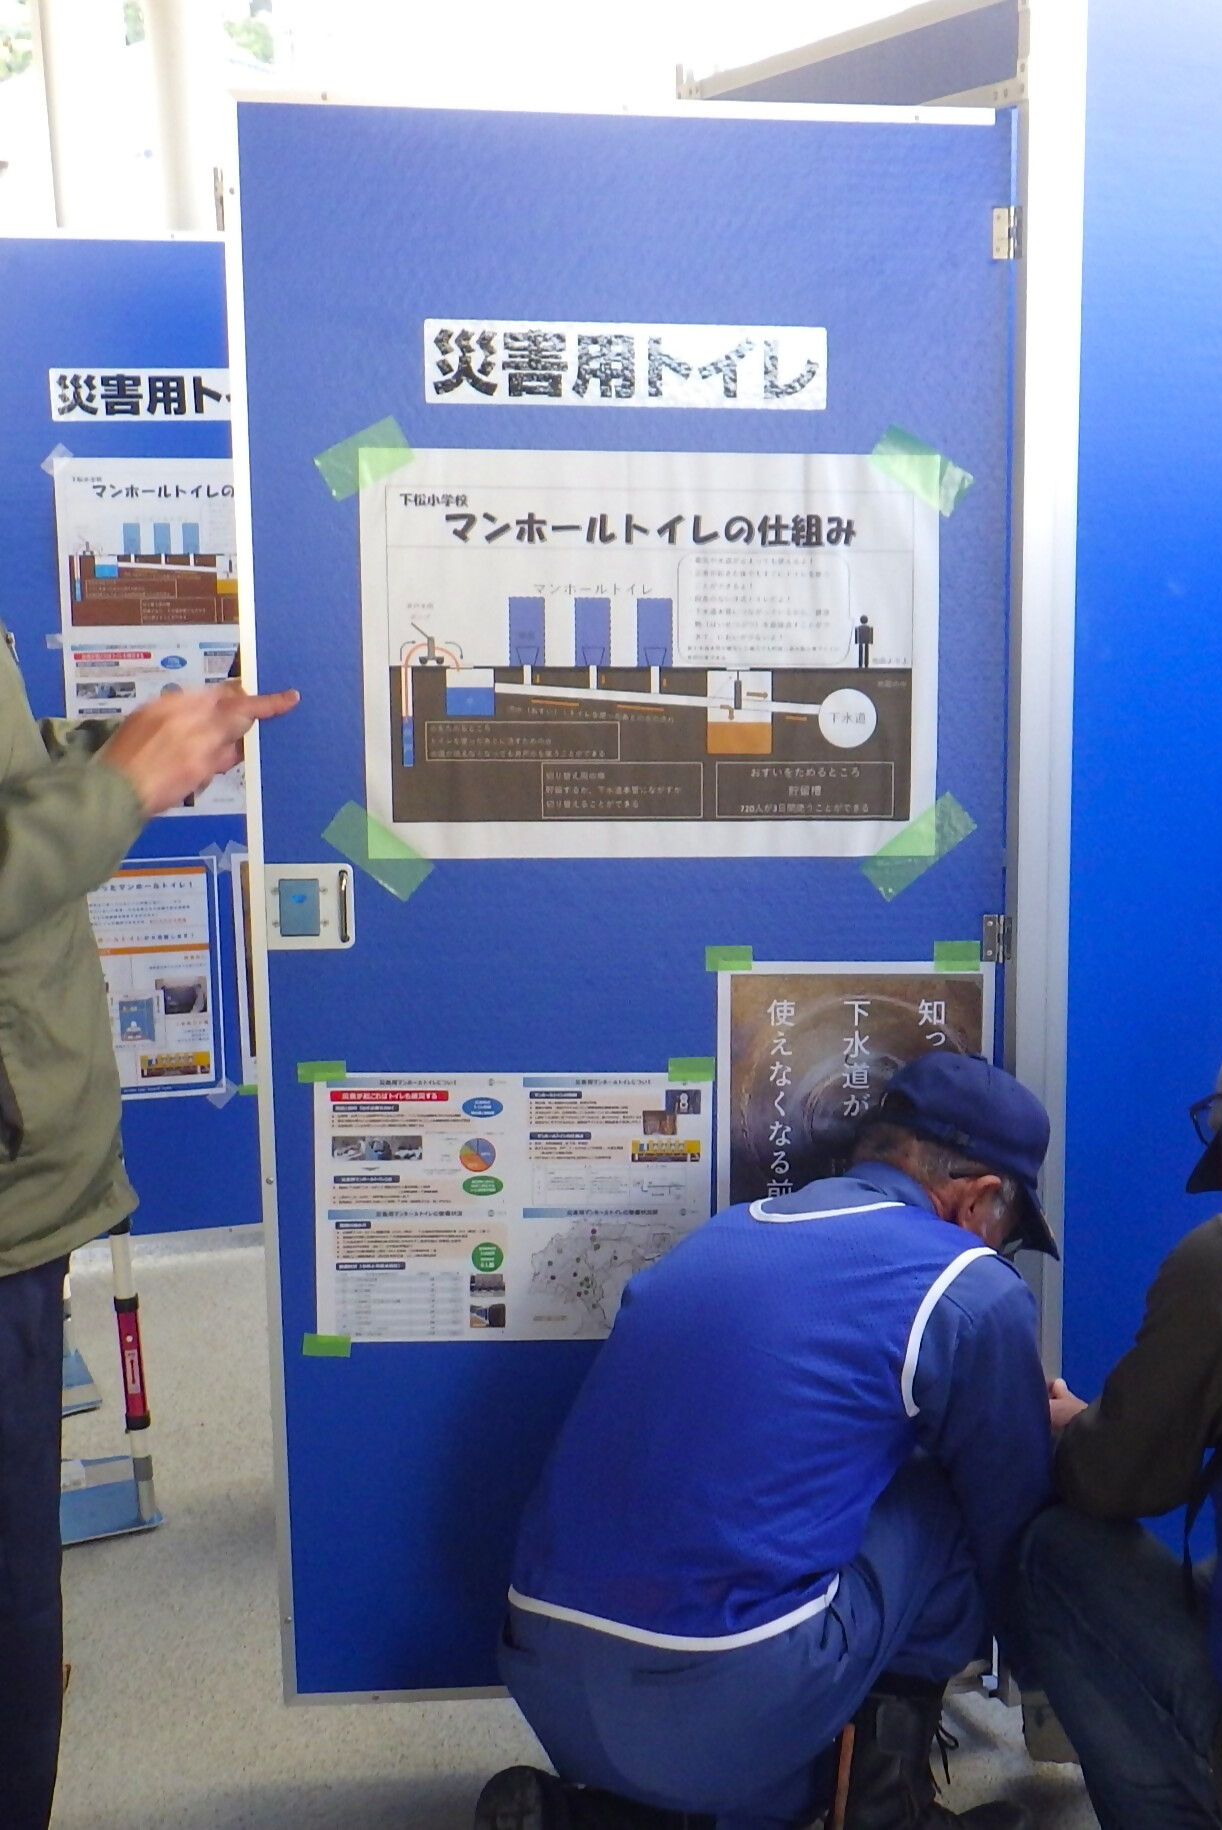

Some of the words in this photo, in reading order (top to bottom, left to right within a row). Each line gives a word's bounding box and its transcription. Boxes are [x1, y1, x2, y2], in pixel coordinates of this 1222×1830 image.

[432, 327, 819, 399] 災害用トイレ
[57, 373, 231, 416] 災害用ト
[92, 484, 235, 499] マンホールトイレの
[399, 492, 469, 507] 下松小学校
[444, 511, 858, 548] マンホールトイレの仕組み
[533, 583, 653, 596] マンホールトイレ
[828, 711, 867, 725] 下水道
[750, 767, 861, 779] おすいをためるところ
[918, 999, 947, 1047] 知っ
[842, 1000, 872, 1117] 下水道が
[766, 999, 796, 1199] 使えなくなる前
